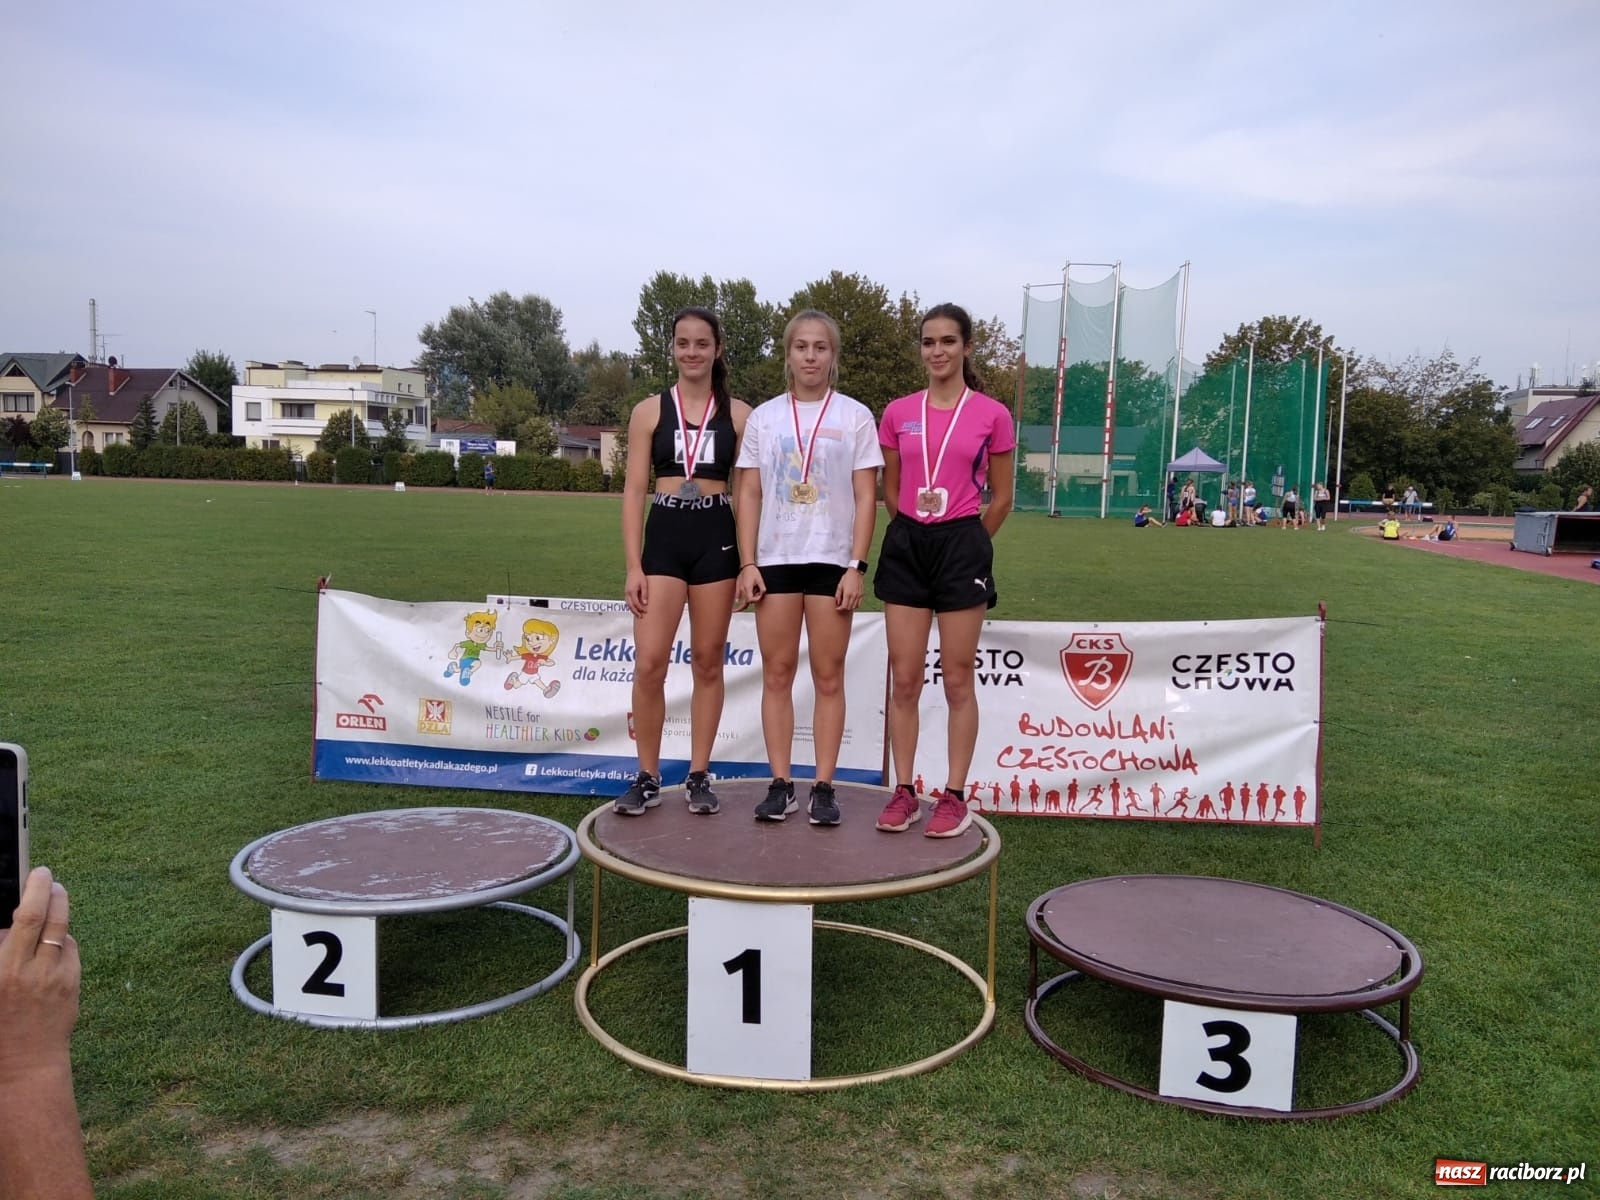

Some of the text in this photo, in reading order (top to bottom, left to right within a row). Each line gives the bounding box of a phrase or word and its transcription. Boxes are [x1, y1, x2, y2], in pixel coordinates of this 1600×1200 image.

[1076, 638, 1114, 651] CKS
[572, 666, 597, 681] dla
[1078, 656, 1114, 691] B
[338, 714, 384, 729] ORLEN
[526, 711, 541, 724] for
[486, 723, 582, 742] HEALTHIER KIDS
[345, 756, 498, 774] www.lekkoatletykadlakazdego.pl
[541, 766, 606, 780] Lekkoatletyka
[607, 770, 622, 780] dla
[301, 930, 345, 998] 2
[722, 948, 762, 1025] 1
[1195, 1020, 1252, 1094] 3
